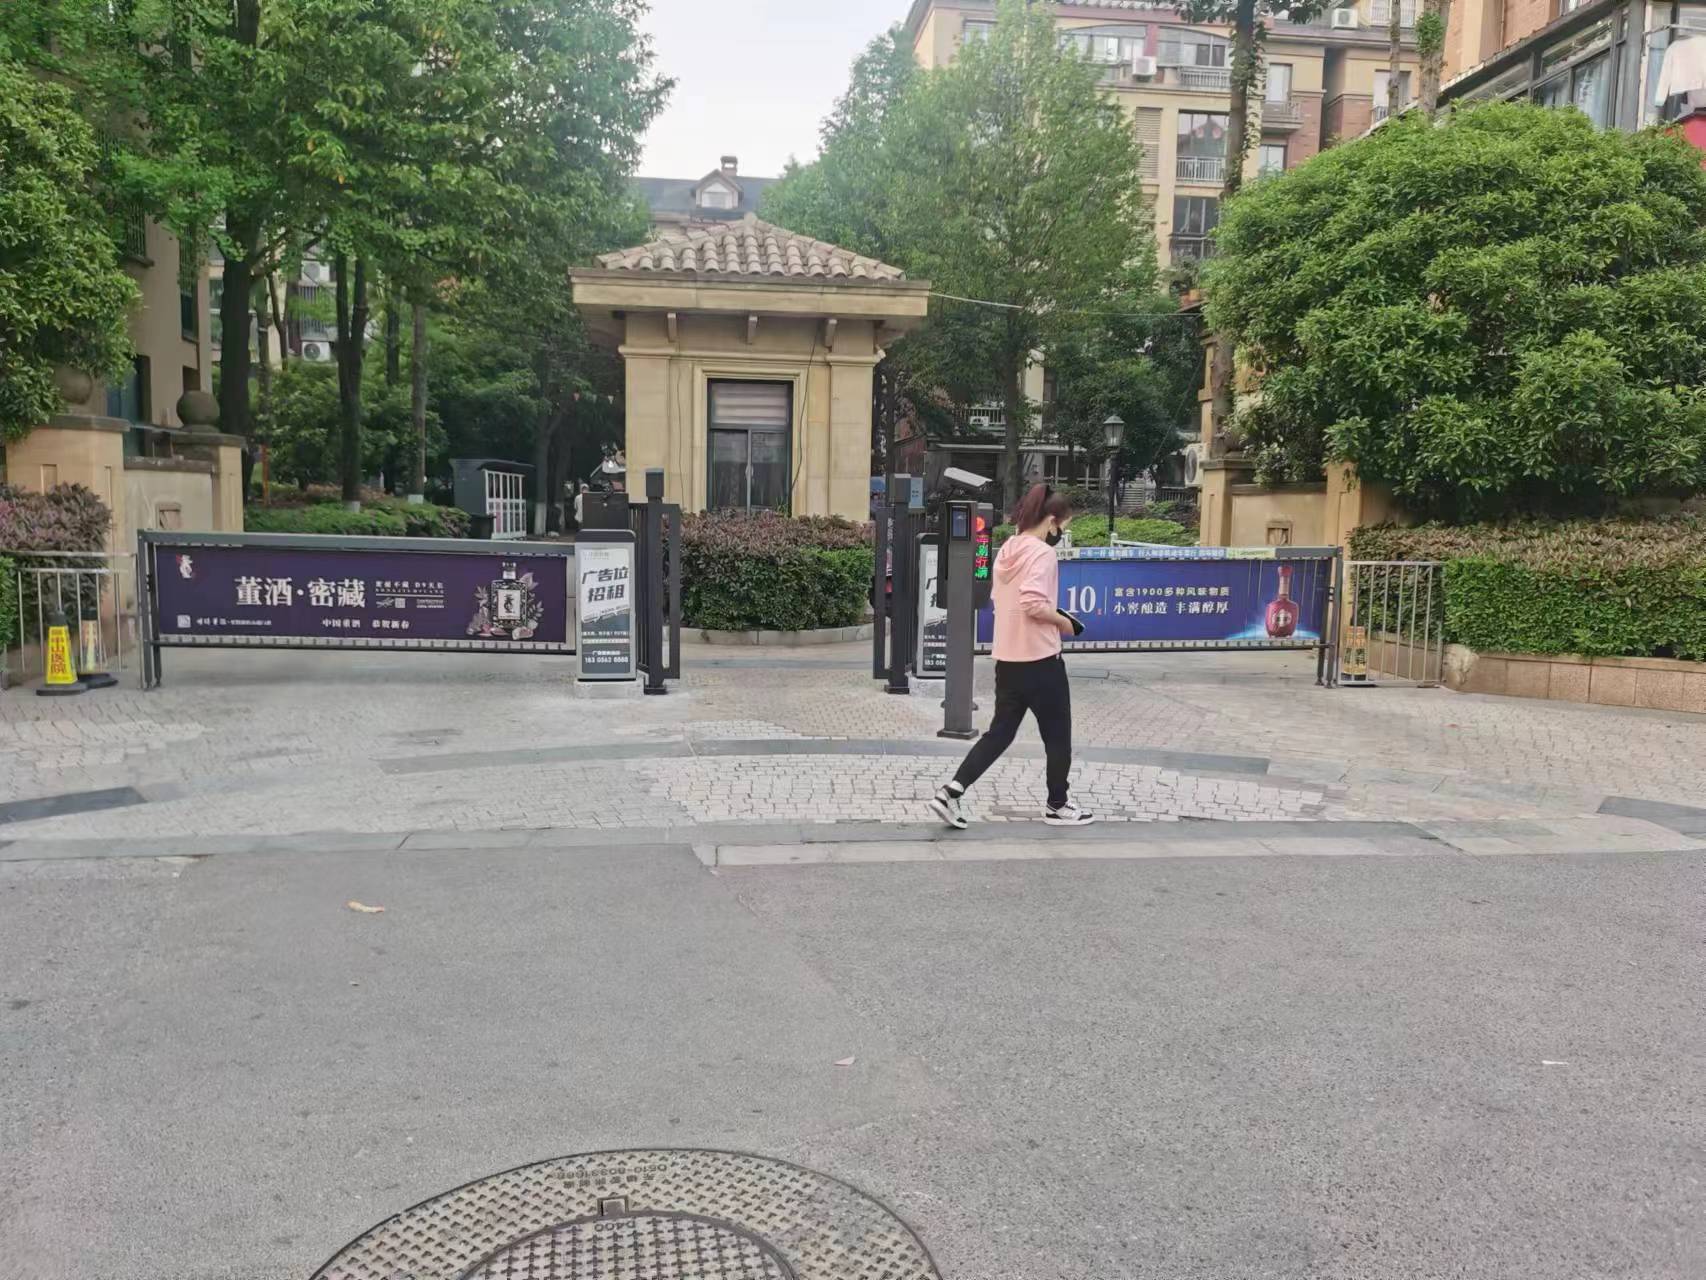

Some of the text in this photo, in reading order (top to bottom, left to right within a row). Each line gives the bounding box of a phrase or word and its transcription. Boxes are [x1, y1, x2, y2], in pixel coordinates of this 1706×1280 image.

[582, 566, 629, 584] 广告位
[234, 576, 366, 608] 董酒·密藏
[588, 584, 625, 603] 招租
[1066, 585, 1096, 614] 10
[1114, 586, 1230, 597] 富含1900多种风味物质
[1176, 601, 1230, 615] 丰满醇厚
